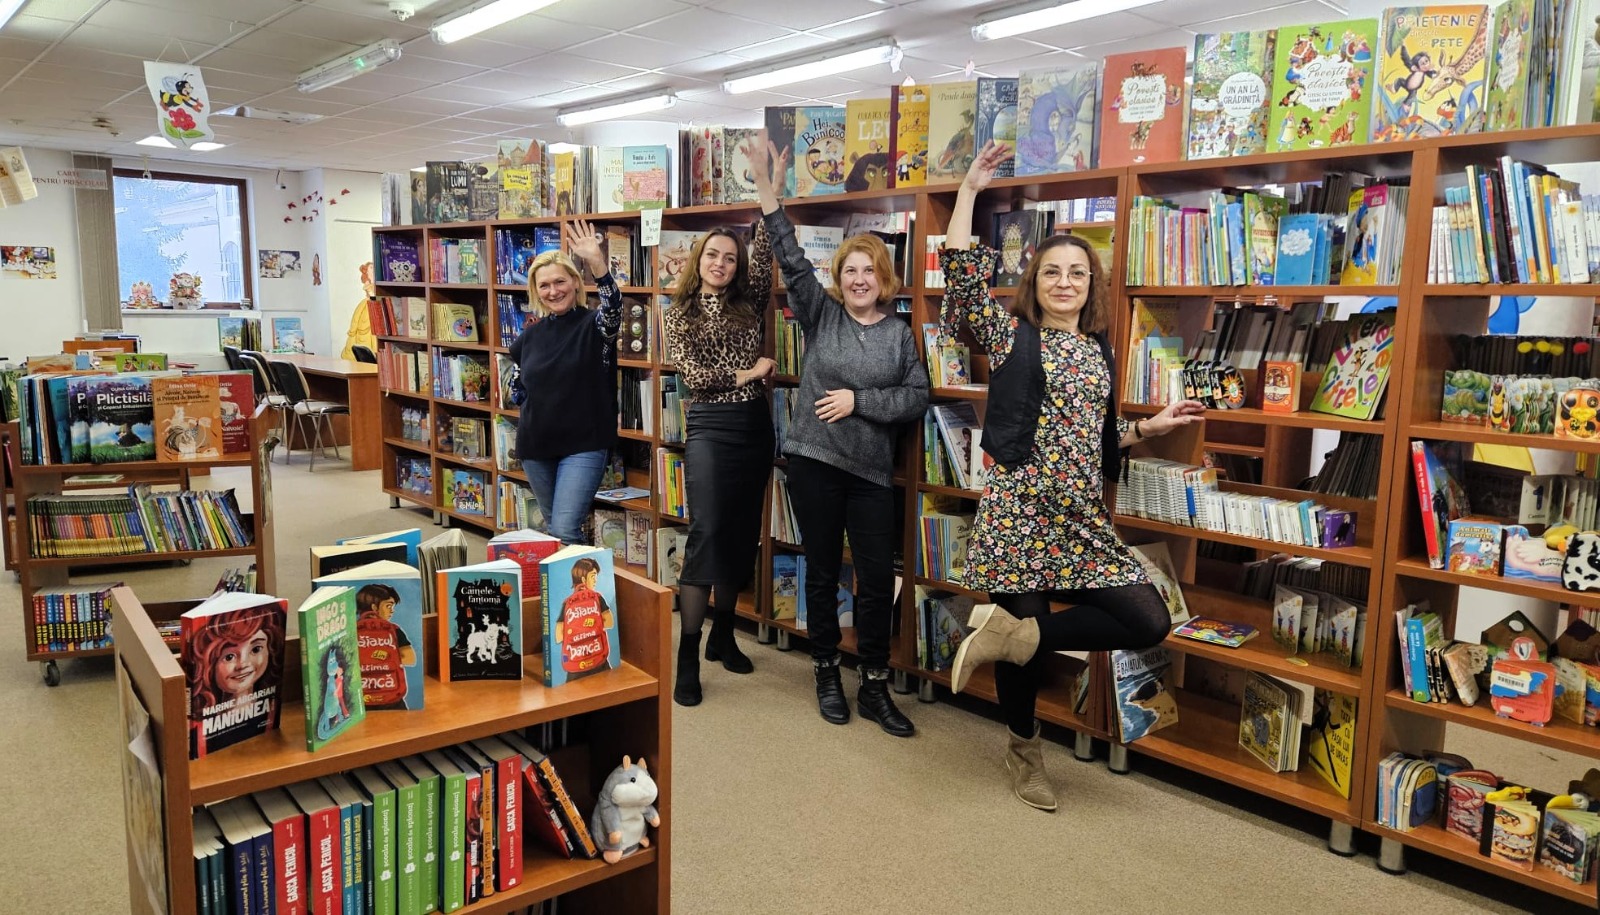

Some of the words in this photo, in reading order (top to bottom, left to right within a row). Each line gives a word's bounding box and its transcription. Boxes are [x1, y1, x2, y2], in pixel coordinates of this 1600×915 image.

[1431, 37, 1464, 48] PETE
[1226, 85, 1236, 94] UN
[1238, 84, 1248, 94] AN
[1250, 84, 1259, 94] LA
[801, 128, 846, 147] Bunicoo
[1532, 484, 1545, 511] 1
[357, 633, 397, 650] ăiatul
[361, 663, 390, 672] ltima
[361, 673, 396, 690] ancă
